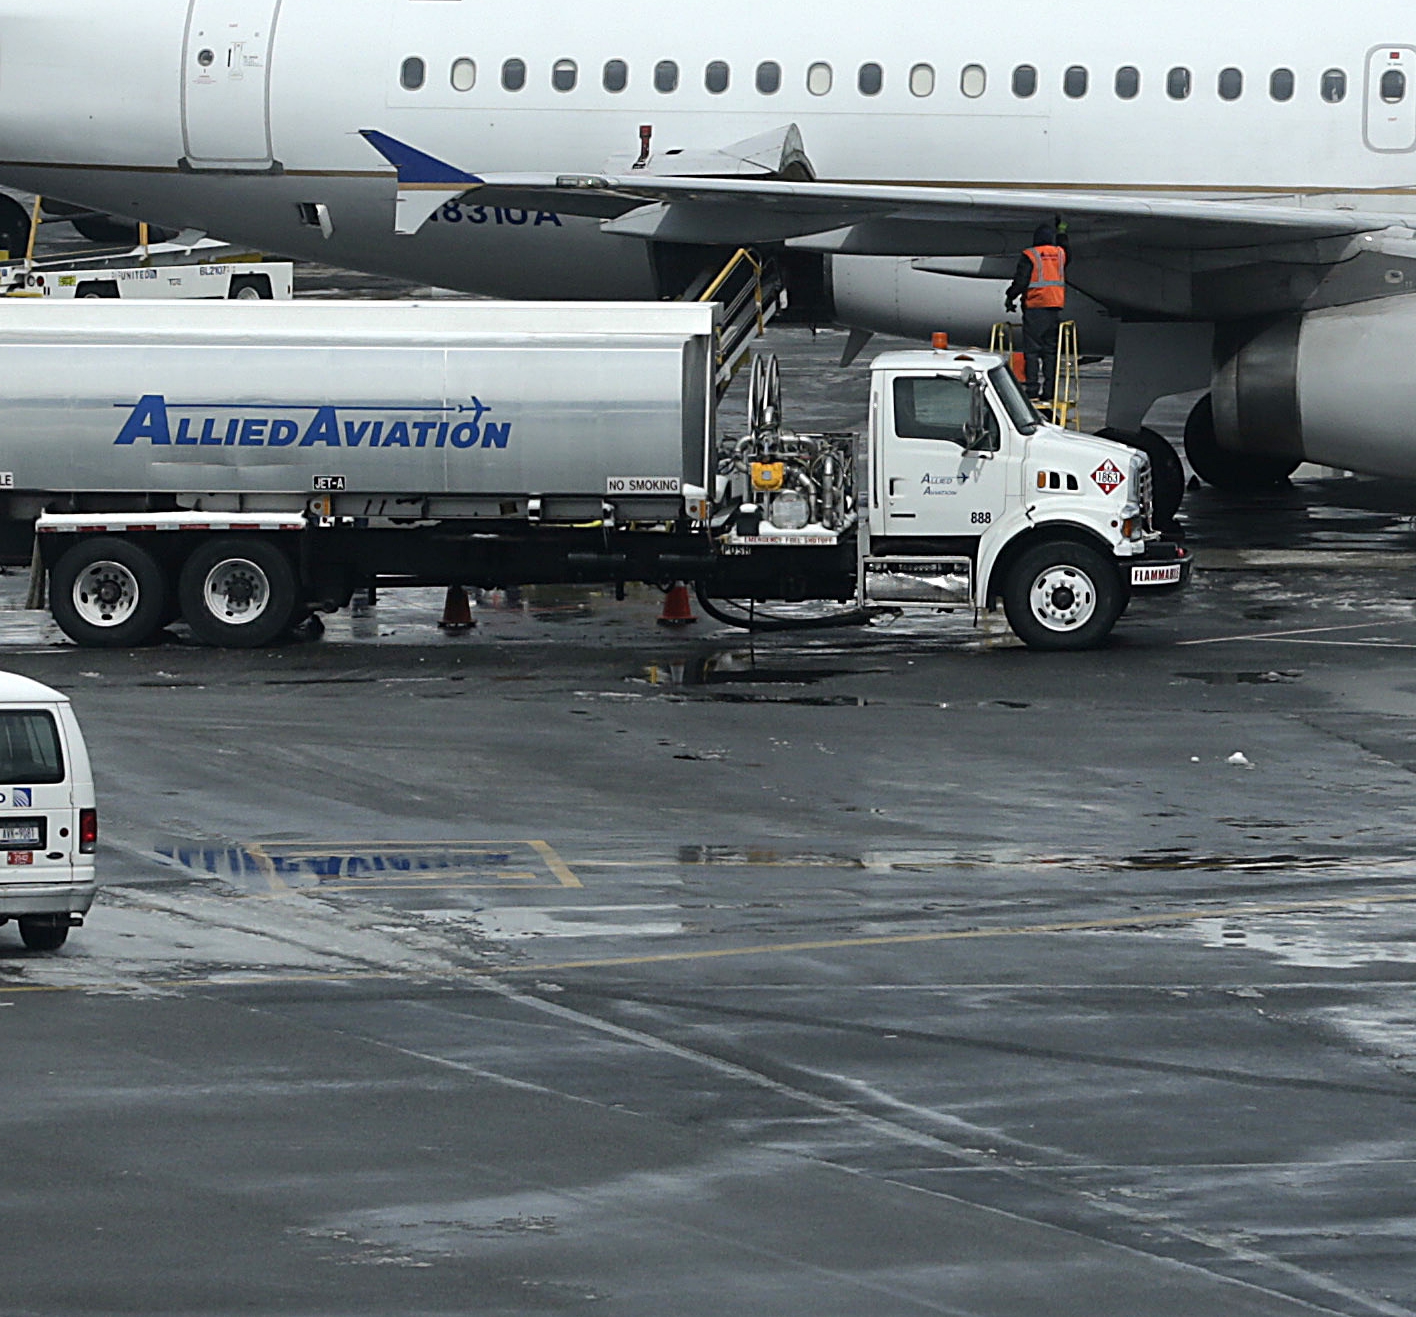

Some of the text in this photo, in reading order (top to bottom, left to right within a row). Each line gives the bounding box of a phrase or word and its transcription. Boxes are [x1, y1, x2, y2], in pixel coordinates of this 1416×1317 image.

[121, 270, 149, 280] UNITED
[315, 477, 344, 489] JET-A
[1097, 471, 1118, 484] 1863
[609, 479, 678, 491] NO SMOKING
[971, 512, 991, 524] 888
